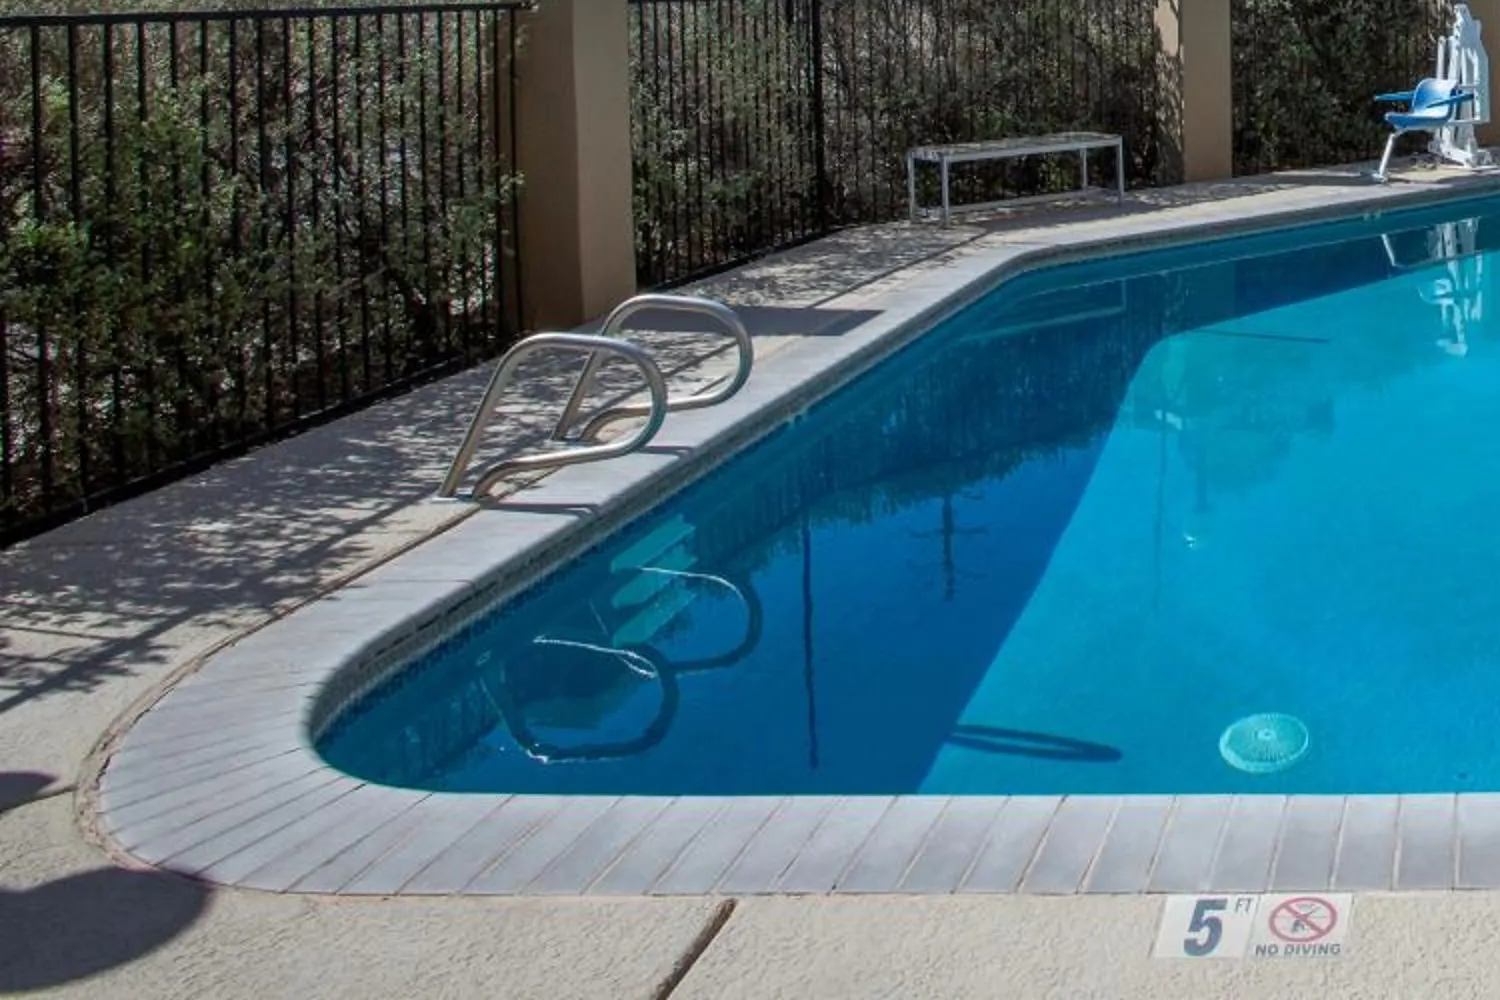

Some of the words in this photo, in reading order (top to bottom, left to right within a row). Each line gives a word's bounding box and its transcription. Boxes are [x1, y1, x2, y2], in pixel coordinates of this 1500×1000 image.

[1183, 898, 1227, 957] 5
[1235, 897, 1252, 913] FT
[1255, 943, 1279, 956] NO
[1284, 943, 1341, 956] DIVING
